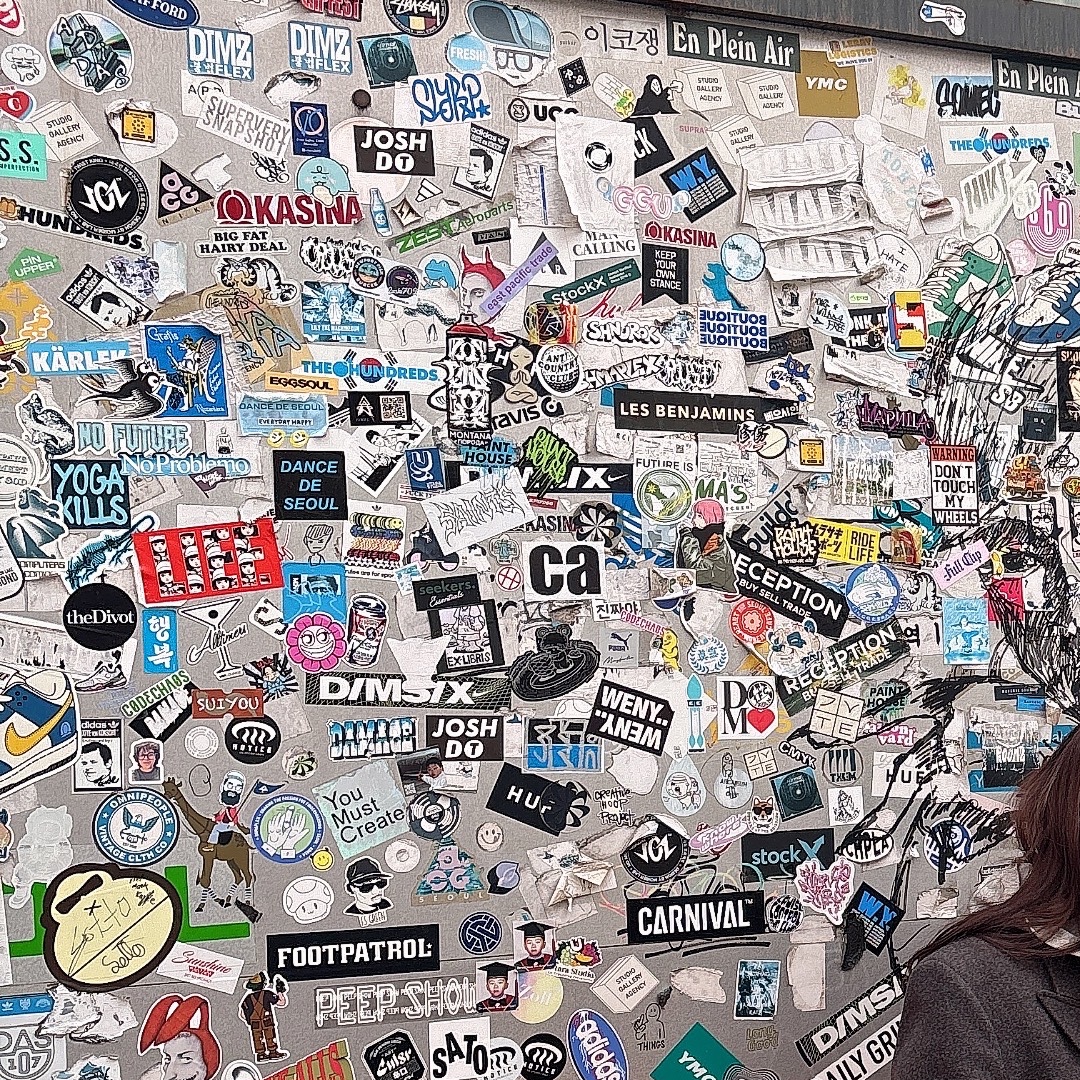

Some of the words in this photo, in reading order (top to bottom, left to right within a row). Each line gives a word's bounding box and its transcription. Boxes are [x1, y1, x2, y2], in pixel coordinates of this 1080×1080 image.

[188, 27, 252, 62] DIMZ
[290, 23, 351, 60] DIMZ
[672, 21, 700, 53] En
[708, 25, 757, 62] Plein
[764, 35, 793, 67] Air
[216, 63, 252, 79] FLEX
[315, 60, 350, 74] FLEX
[804, 77, 848, 92] YMC
[998, 59, 1023, 89] En
[1027, 63, 1070, 96] Plein
[696, 84, 722, 93] GALLERY
[759, 84, 779, 92] STUDIO
[759, 92, 784, 101] GALLERY
[46, 114, 73, 129] STUDIO
[207, 95, 290, 144] SUPERVERY
[49, 123, 82, 139] GALLERY
[202, 111, 288, 155] SNAPSHOT
[57, 134, 86, 149] AGENCY
[360, 129, 427, 151] JOSH
[949, 140, 973, 151] THE
[256, 195, 364, 225] KASINA
[214, 231, 240, 243] BIG
[243, 230, 269, 242] FAT
[663, 226, 718, 249] KASINA
[199, 242, 247, 255] HAIRY
[251, 240, 287, 254] DEAL
[573, 239, 636, 257] CALLING
[655, 249, 677, 259] KEEP
[15, 261, 55, 278] UPPER
[20, 255, 41, 268] PIN
[655, 260, 677, 270] YOUR
[656, 270, 676, 280] OWN
[650, 279, 681, 291] STANCE
[546, 353, 568, 363] ANTI
[302, 360, 335, 375] THE
[269, 376, 333, 391] EGGSOUL
[239, 402, 275, 412] DANCE
[276, 402, 290, 412] DE
[291, 402, 324, 412] SEOUL
[620, 402, 650, 417] LES
[655, 403, 756, 421] BENJAMINS
[113, 423, 190, 453] FUTURE
[464, 452, 513, 465] HOUSE
[932, 447, 975, 462] WARNING
[280, 461, 338, 475] DANCE
[935, 464, 972, 479] DON'T
[55, 462, 125, 496] YOGA
[299, 479, 322, 492] DE
[933, 479, 976, 493] TOUCH
[284, 497, 339, 511] SEOUL
[945, 495, 965, 508] MY
[61, 496, 127, 525] KILLS
[934, 510, 978, 525] WHEELS
[851, 530, 876, 548] RIDE
[848, 546, 875, 563] LIFE
[529, 544, 601, 596] ca
[419, 579, 476, 595] seekers.
[736, 556, 843, 620] ECEPTION
[738, 579, 758, 593] BUY
[759, 585, 782, 601] SELL
[783, 598, 812, 619] TRADE
[66, 609, 135, 625] theDivot
[784, 626, 898, 699] RECEPTION
[197, 697, 260, 713] SUIYOU
[432, 717, 499, 738] JOSH
[779, 742, 816, 768] CMYK
[109, 789, 174, 826] OMNIPEOPLE
[332, 787, 364, 813] You
[331, 798, 381, 829] Must
[339, 809, 406, 844] Create
[637, 897, 750, 936] CARNIVAL
[277, 936, 428, 969] FOOTPATROL
[615, 968, 636, 984] STUDIO
[617, 975, 643, 993] GALLERY
[625, 981, 647, 999] AGENCY
[636, 1039, 666, 1051] THINGS
